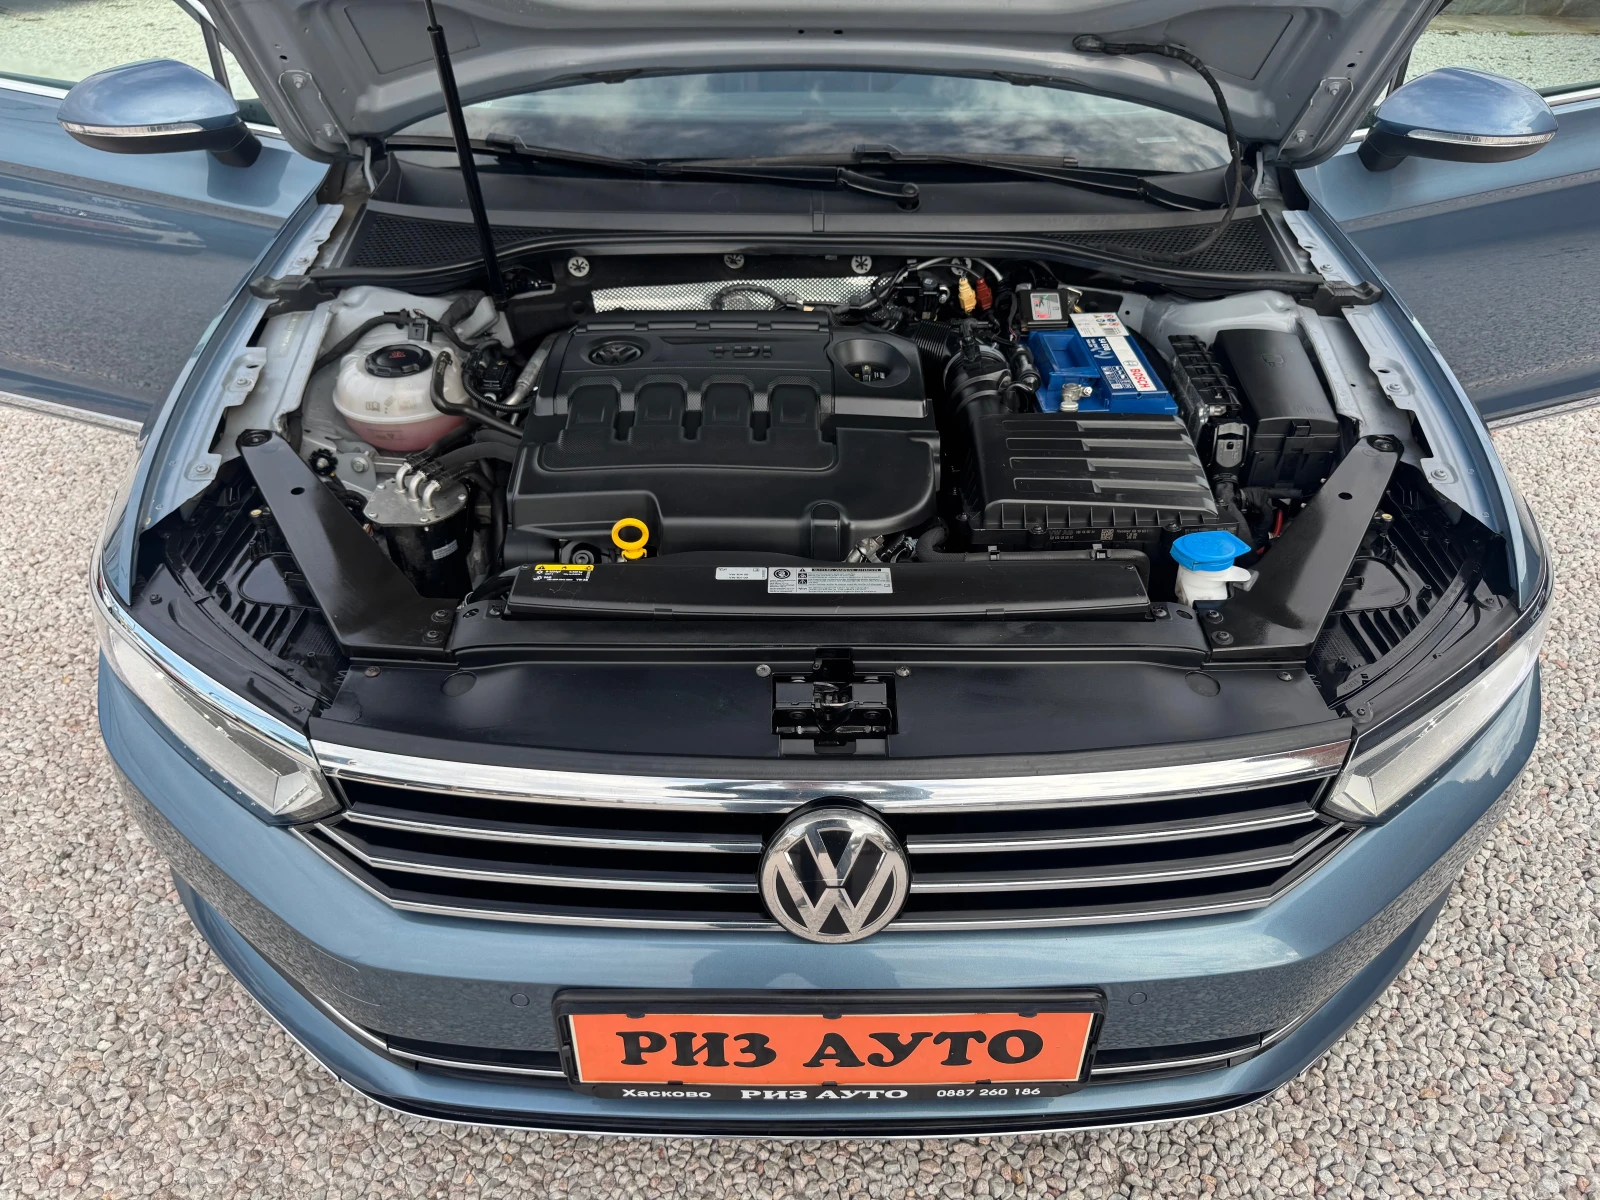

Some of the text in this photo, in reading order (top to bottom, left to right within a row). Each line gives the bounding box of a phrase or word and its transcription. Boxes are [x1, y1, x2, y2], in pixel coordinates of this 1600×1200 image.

[708, 345, 772, 358] TDI
[1129, 368, 1151, 389] BOSCH
[764, 811, 905, 941] VW
[615, 1029, 1044, 1068] РИЗ АУТО
[621, 1088, 712, 1098] Хасково
[740, 1089, 908, 1100] РИЗ АУТО
[936, 1089, 975, 1097] 0887
[979, 1088, 1008, 1096] 260
